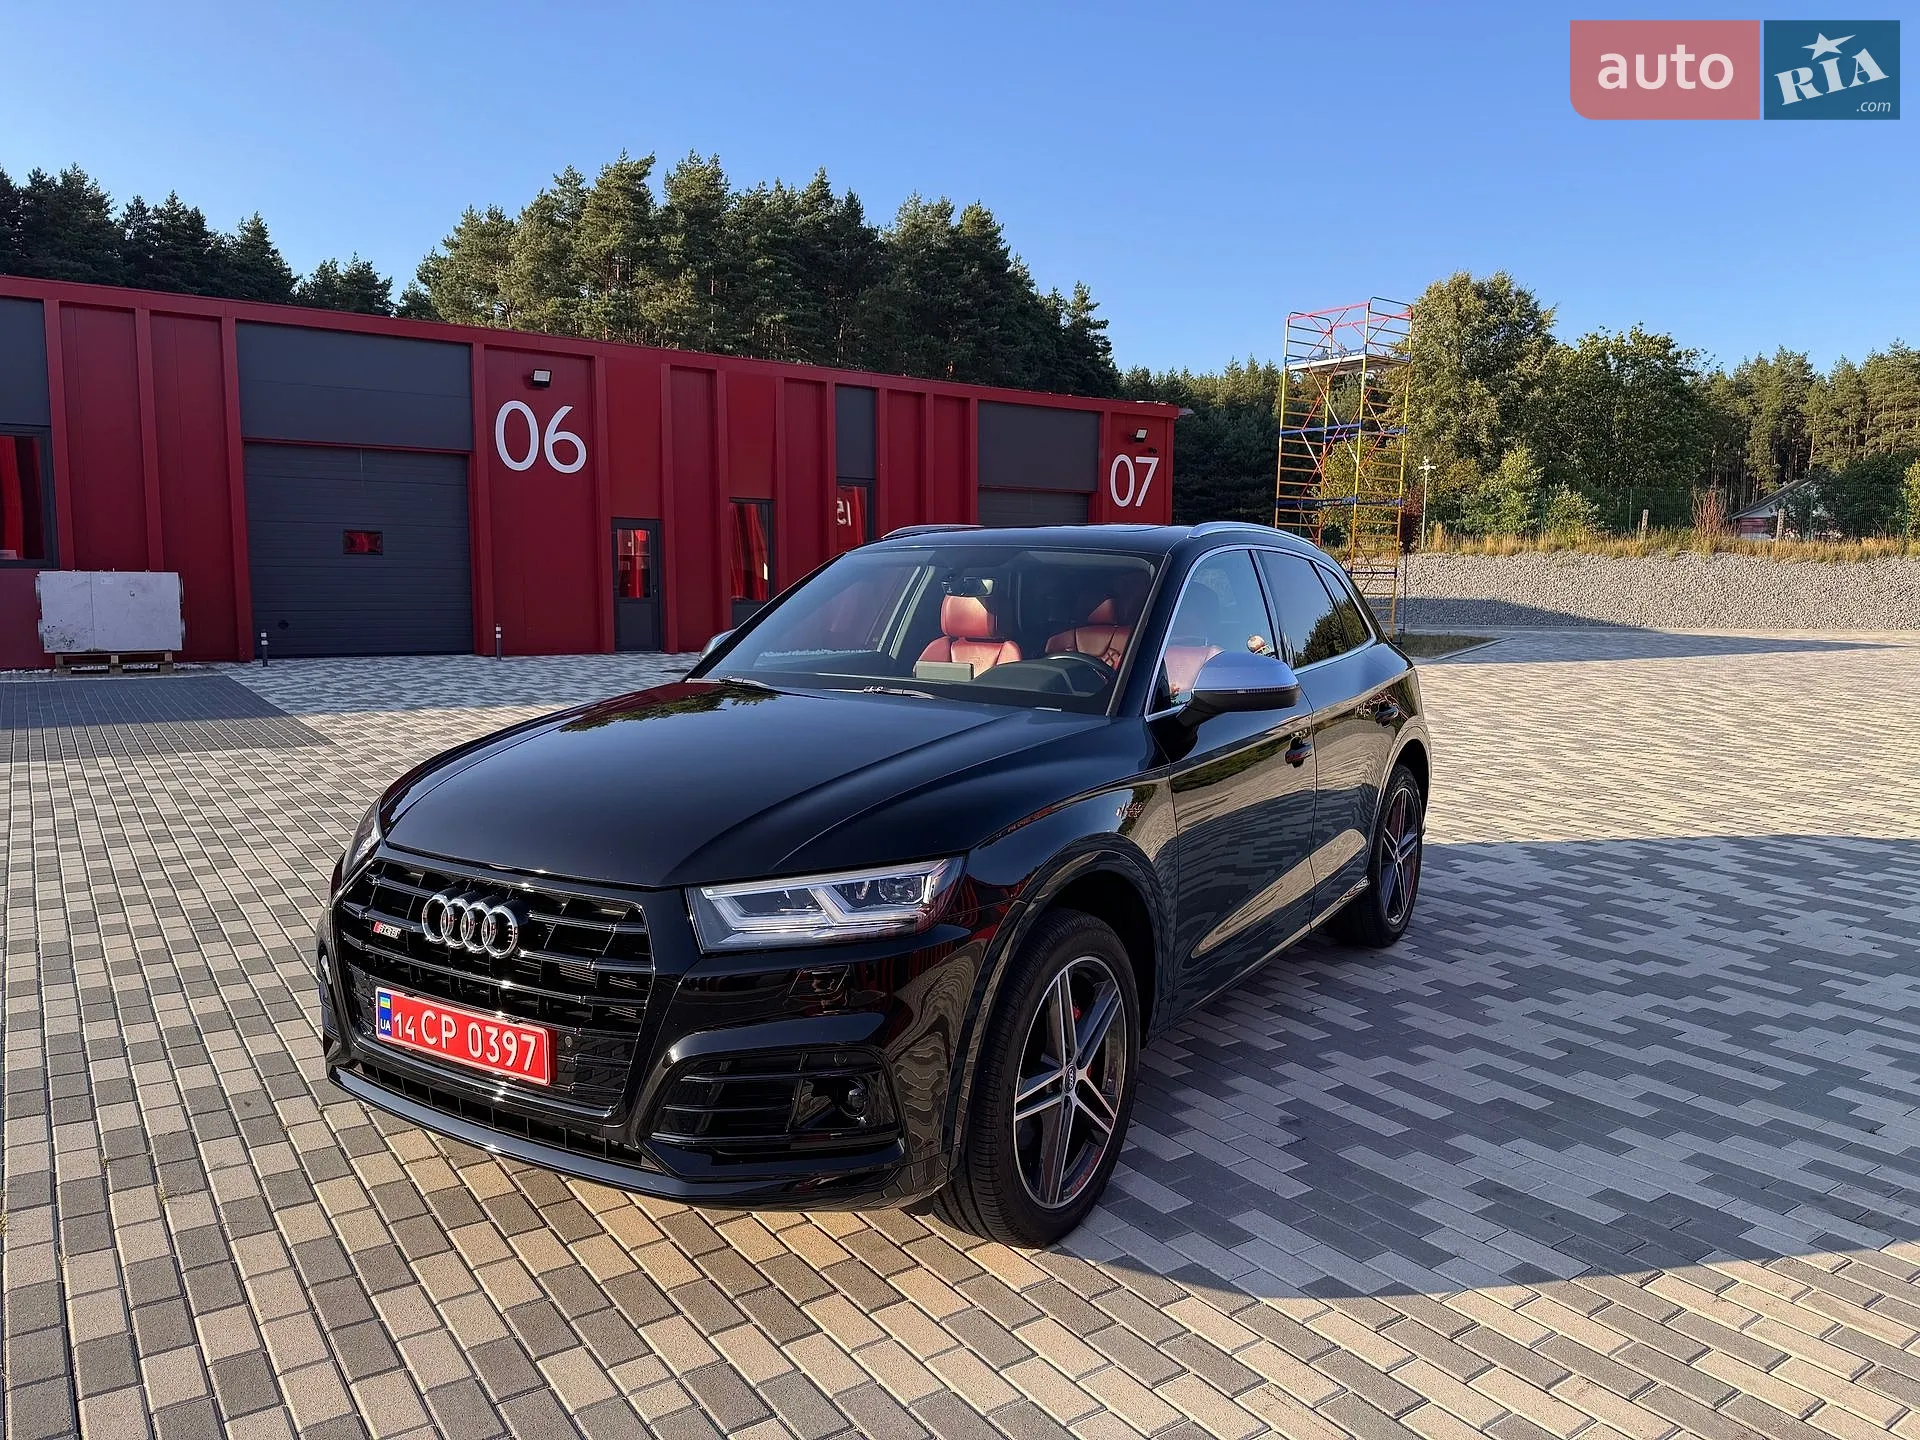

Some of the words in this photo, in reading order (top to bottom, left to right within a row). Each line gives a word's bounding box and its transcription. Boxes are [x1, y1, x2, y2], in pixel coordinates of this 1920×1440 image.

[495, 400, 587, 474] 06
[1110, 454, 1160, 507] 07
[380, 1018, 391, 1032] UA
[467, 1022, 537, 1071] 0397
